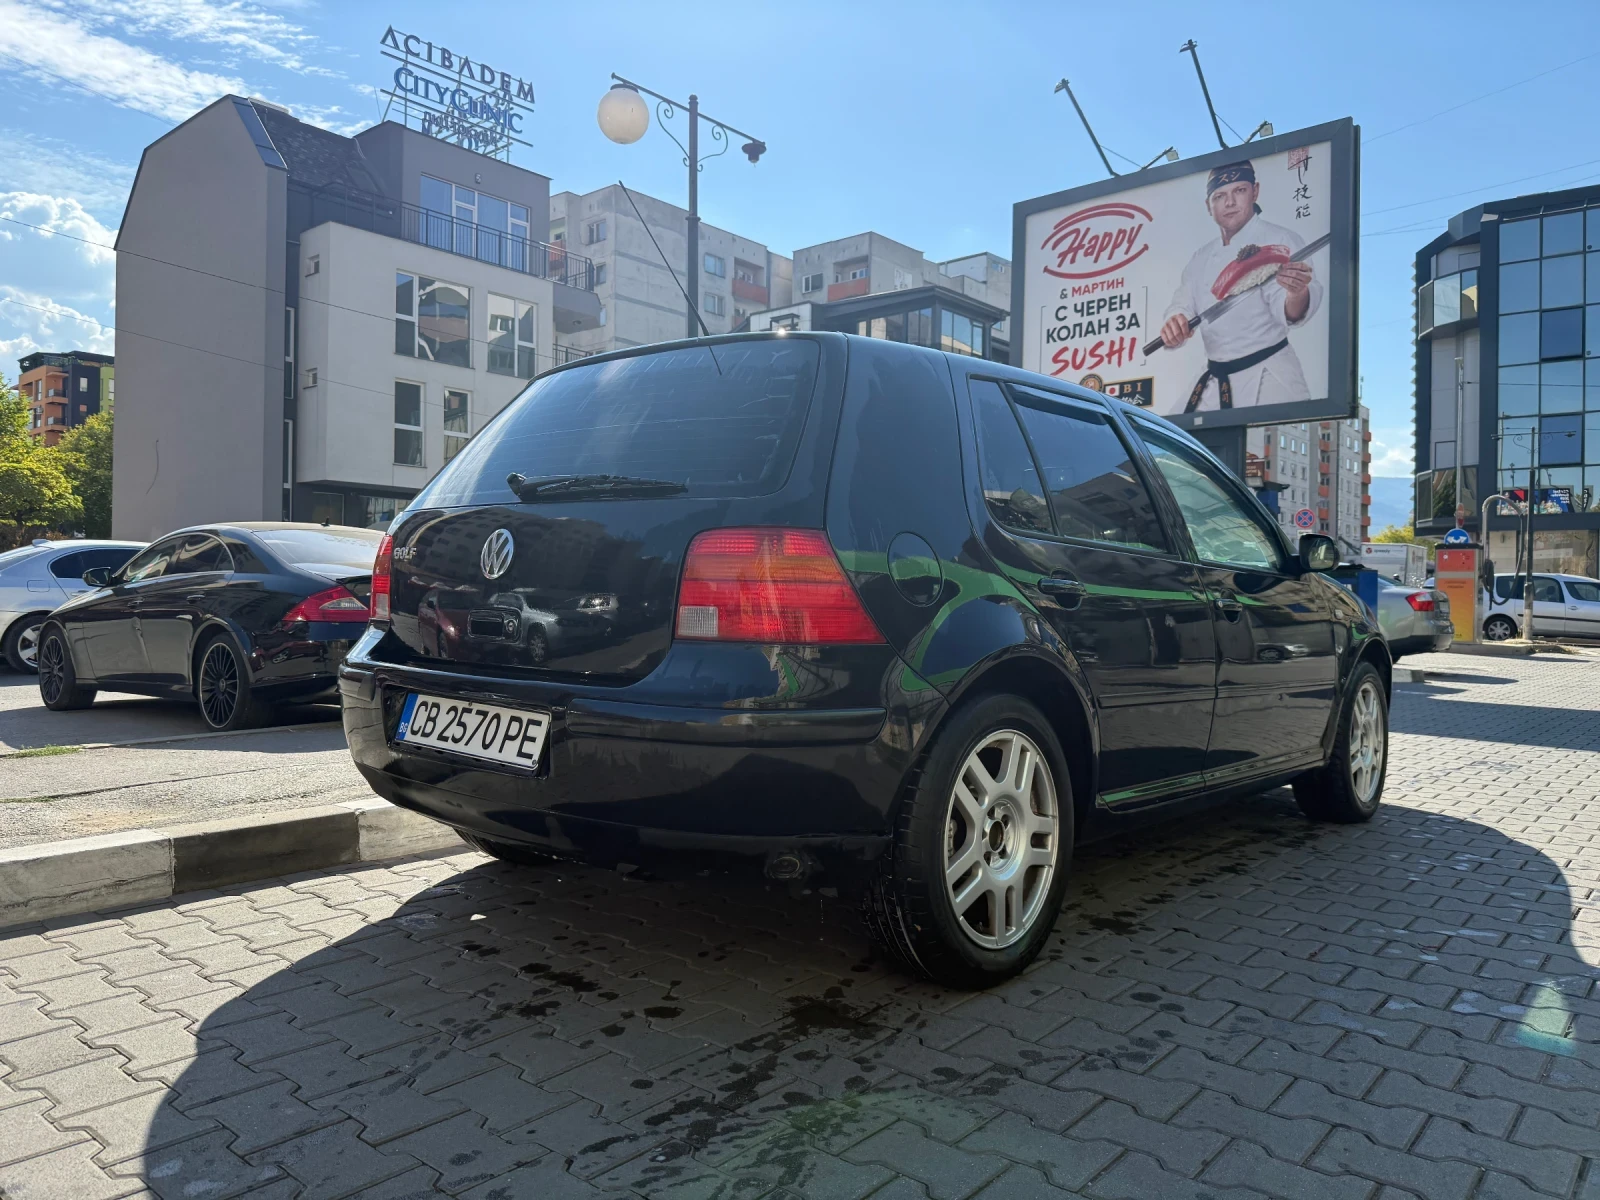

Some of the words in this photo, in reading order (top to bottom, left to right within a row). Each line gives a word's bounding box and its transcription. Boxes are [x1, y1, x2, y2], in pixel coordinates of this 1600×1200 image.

[1051, 223, 1143, 268] Happy
[1071, 277, 1124, 297] МАРТИН
[1073, 293, 1131, 318] ЧЕРЕН
[1046, 317, 1109, 344] КОЛАН
[1115, 312, 1140, 332] ЗА
[1050, 336, 1137, 376] SUSHI
[394, 547, 417, 560] GOLF
[399, 722, 408, 733] BG
